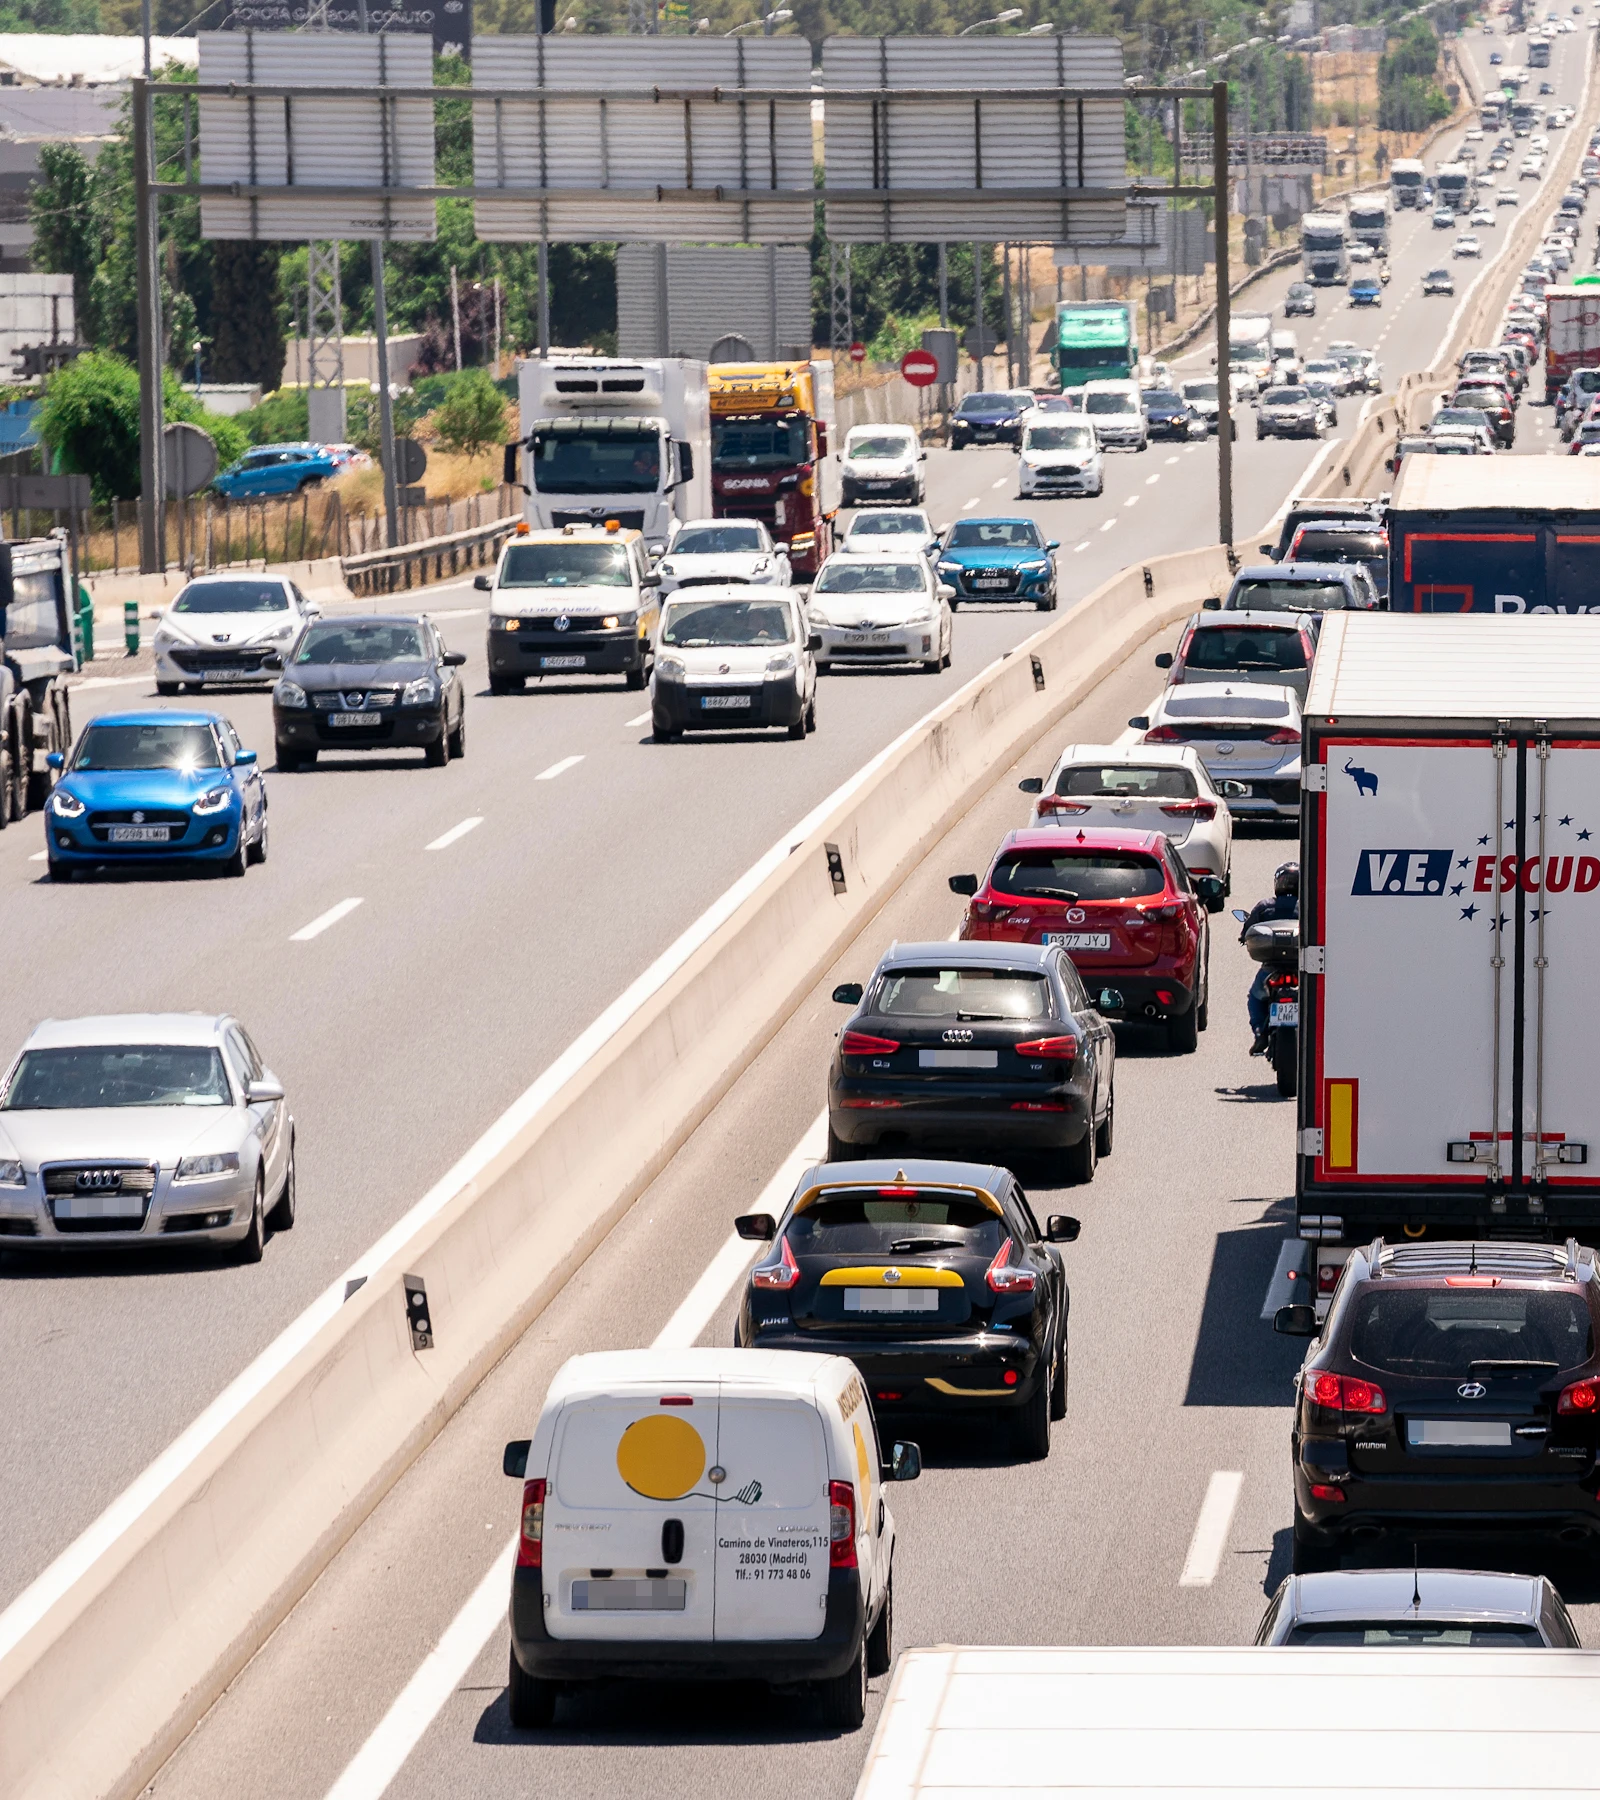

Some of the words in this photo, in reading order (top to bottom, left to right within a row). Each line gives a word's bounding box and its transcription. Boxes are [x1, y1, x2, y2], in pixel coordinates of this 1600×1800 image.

[723, 478, 770, 489] SCANIA
[1368, 854, 1440, 892] V.E.
[1050, 935, 1080, 946] 0377
[1085, 935, 1108, 946] JYJ
[1278, 1004, 1298, 1013] 9125
[718, 1538, 751, 1548] Camino
[754, 1537, 765, 1547] de
[739, 1553, 767, 1564] 28030
[769, 1552, 807, 1566] (Madrid)
[754, 1569, 764, 1580] 91
[768, 1569, 783, 1580] 773
[786, 1569, 797, 1580] 48
[800, 1569, 811, 1579] 06
